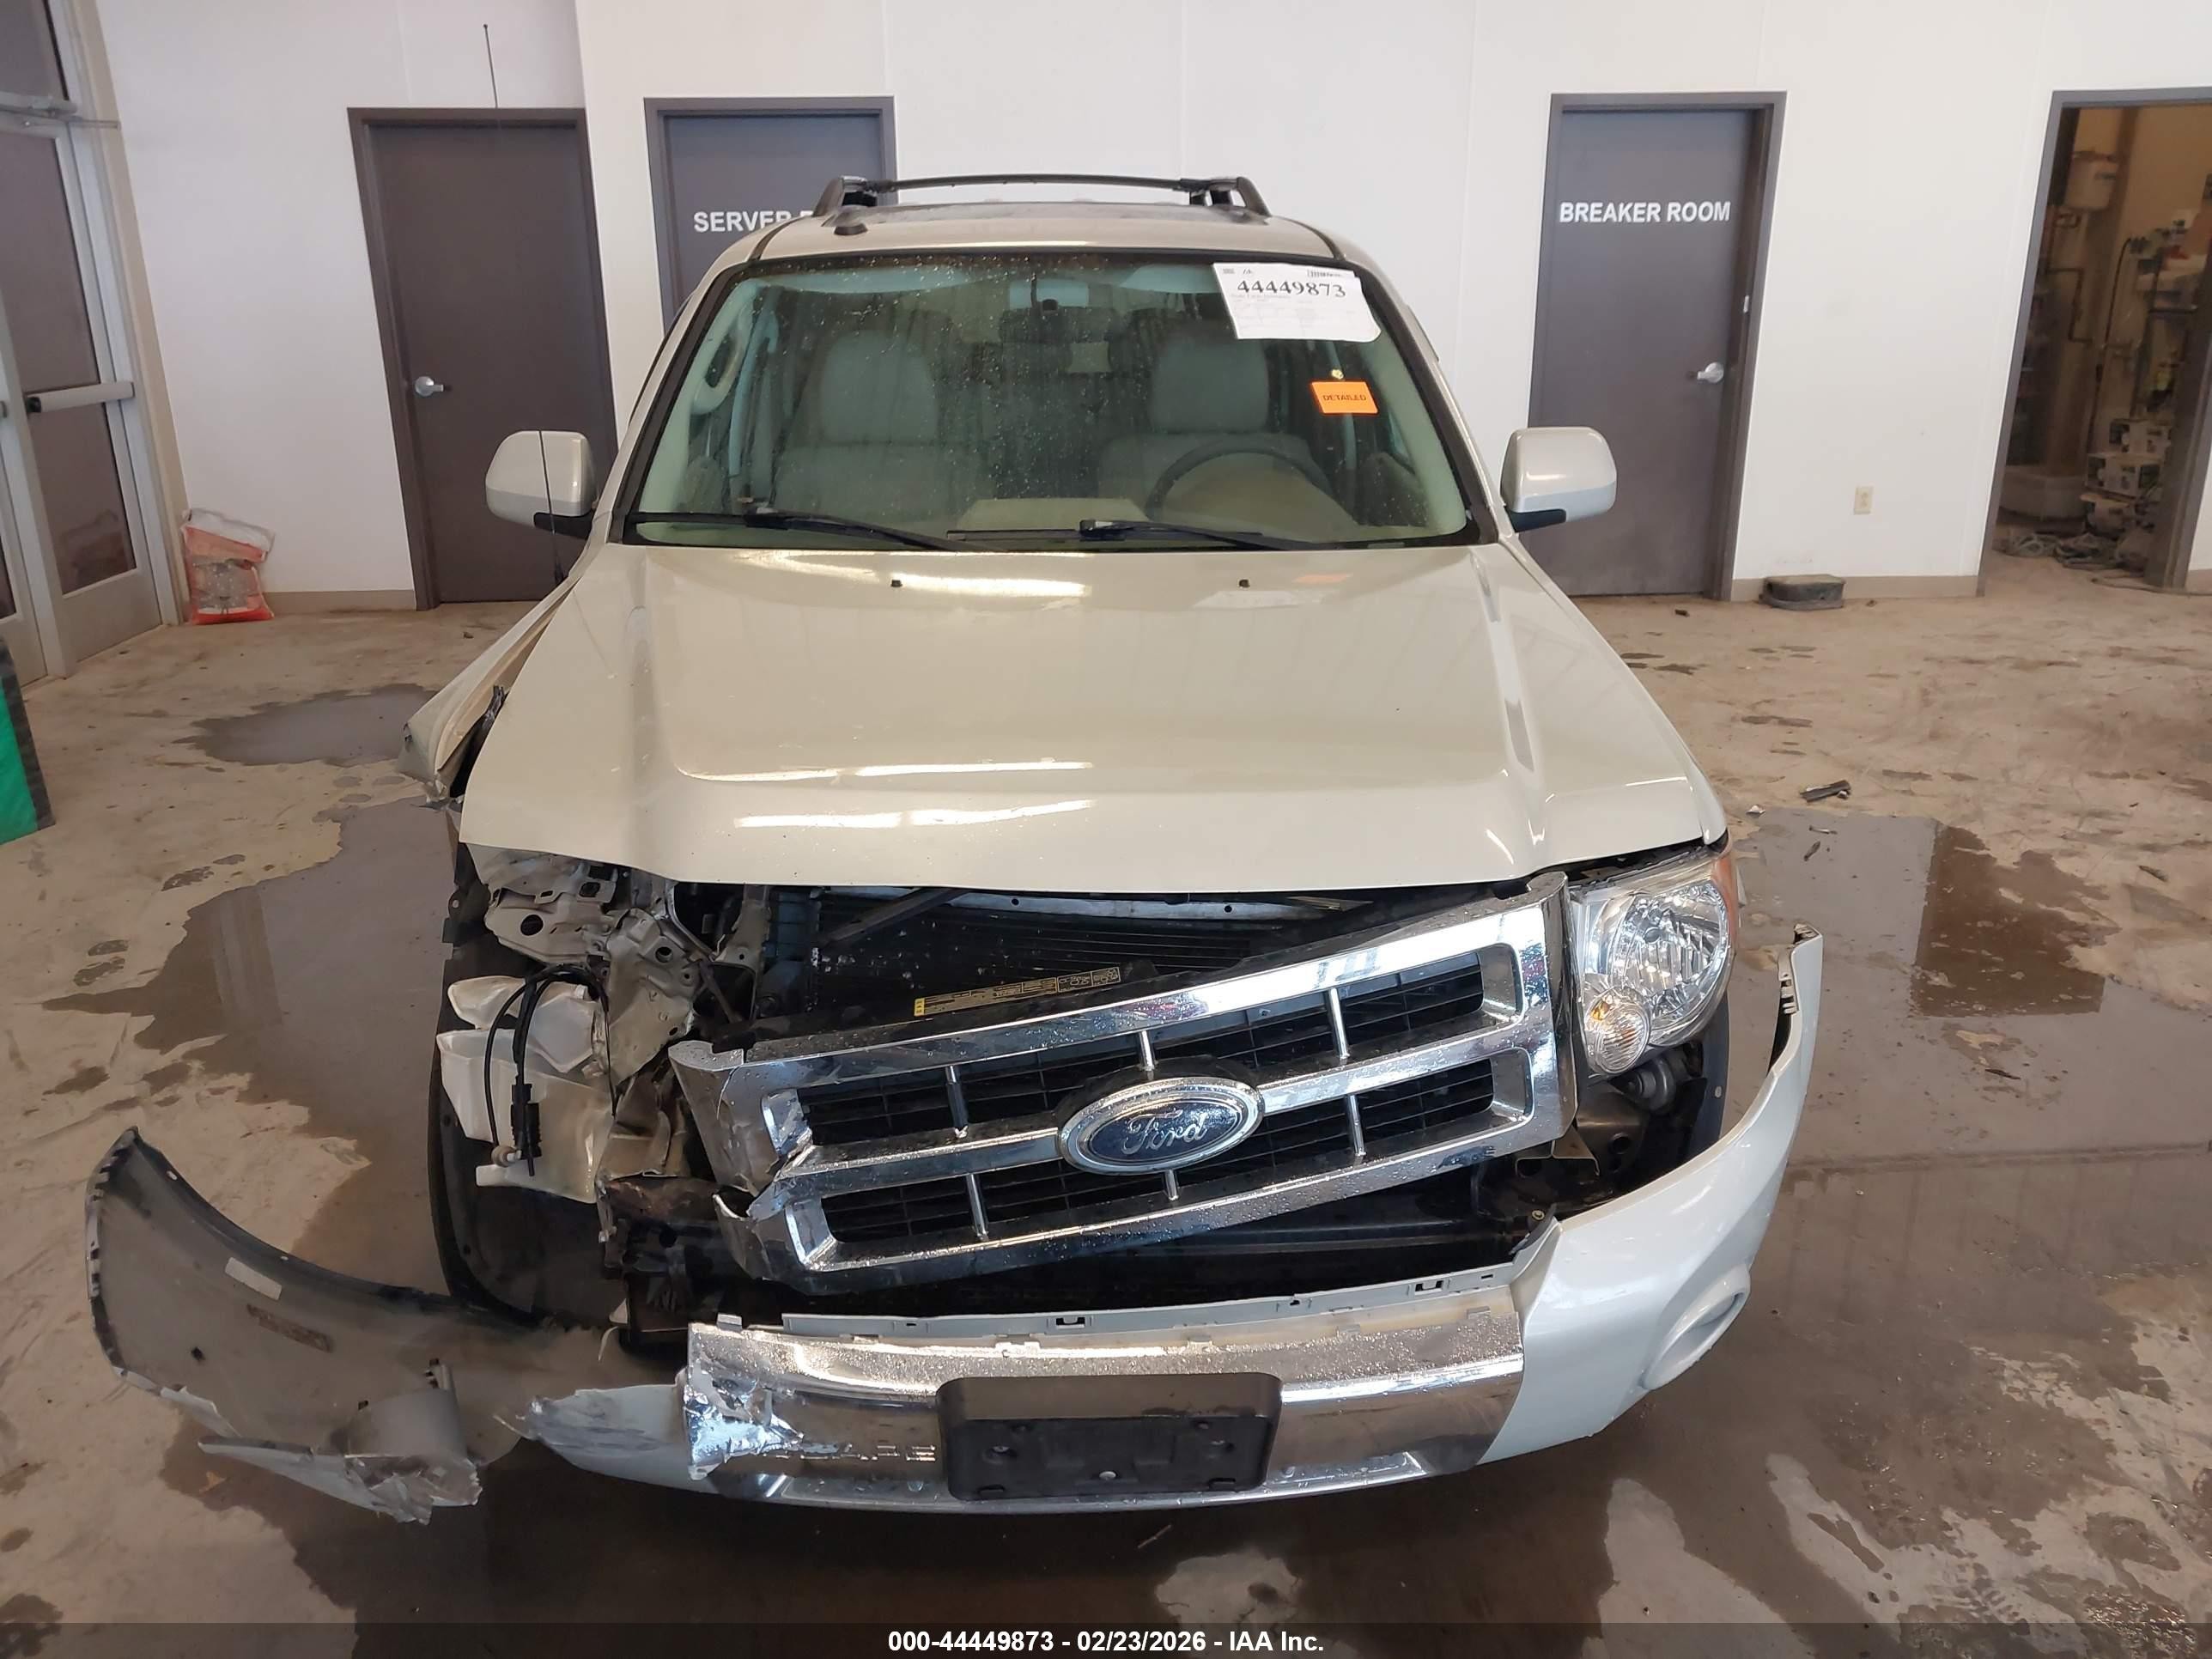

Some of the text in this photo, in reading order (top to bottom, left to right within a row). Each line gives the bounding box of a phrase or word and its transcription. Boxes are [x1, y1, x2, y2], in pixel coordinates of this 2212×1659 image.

[1559, 201, 1732, 223] BREAKER ROOM
[1237, 280, 1346, 298] 44449873
[1121, 1109, 1208, 1155] Ford
